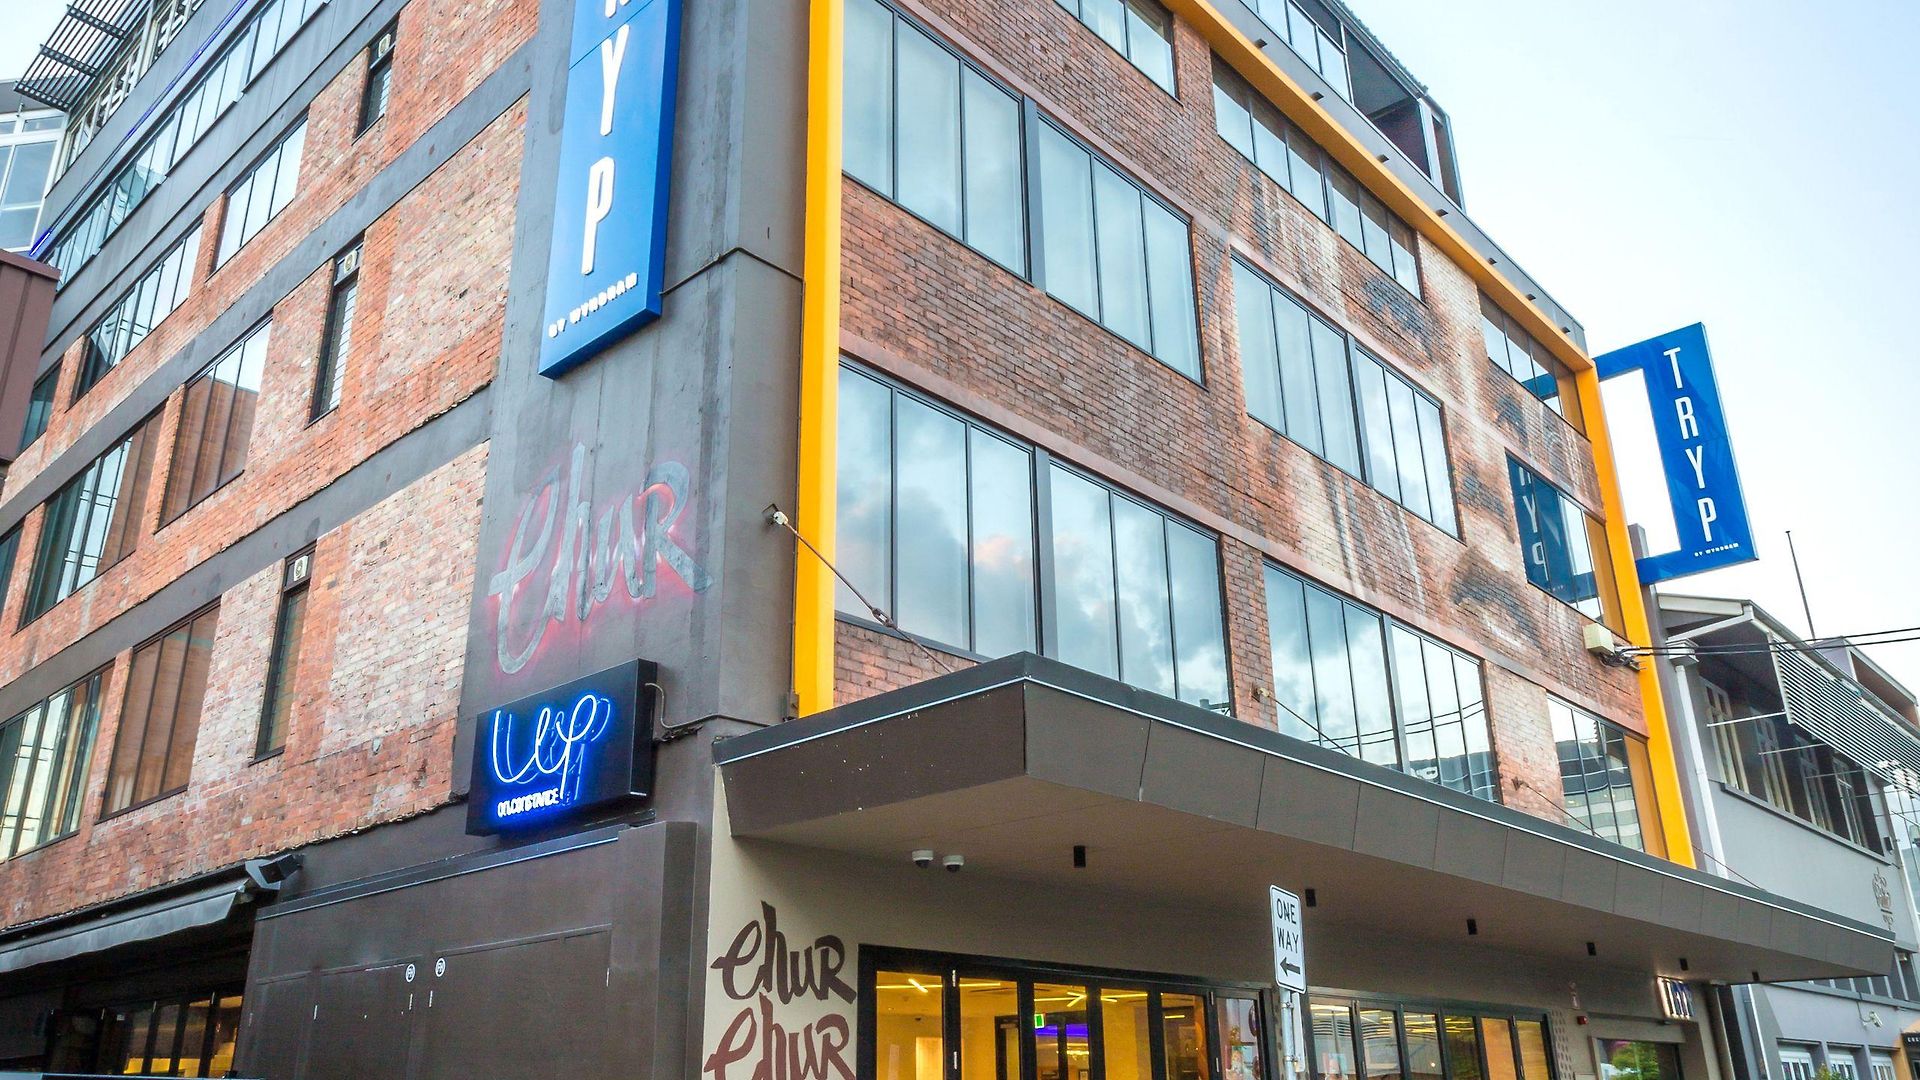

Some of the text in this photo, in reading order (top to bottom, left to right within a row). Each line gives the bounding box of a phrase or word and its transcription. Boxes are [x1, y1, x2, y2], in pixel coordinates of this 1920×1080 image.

[581, 0, 631, 275] YP
[548, 271, 639, 338] BY WYNDHAM
[1663, 346, 1718, 542] TRYP
[1276, 898, 1297, 925] ONE
[1276, 926, 1299, 954] WAY
